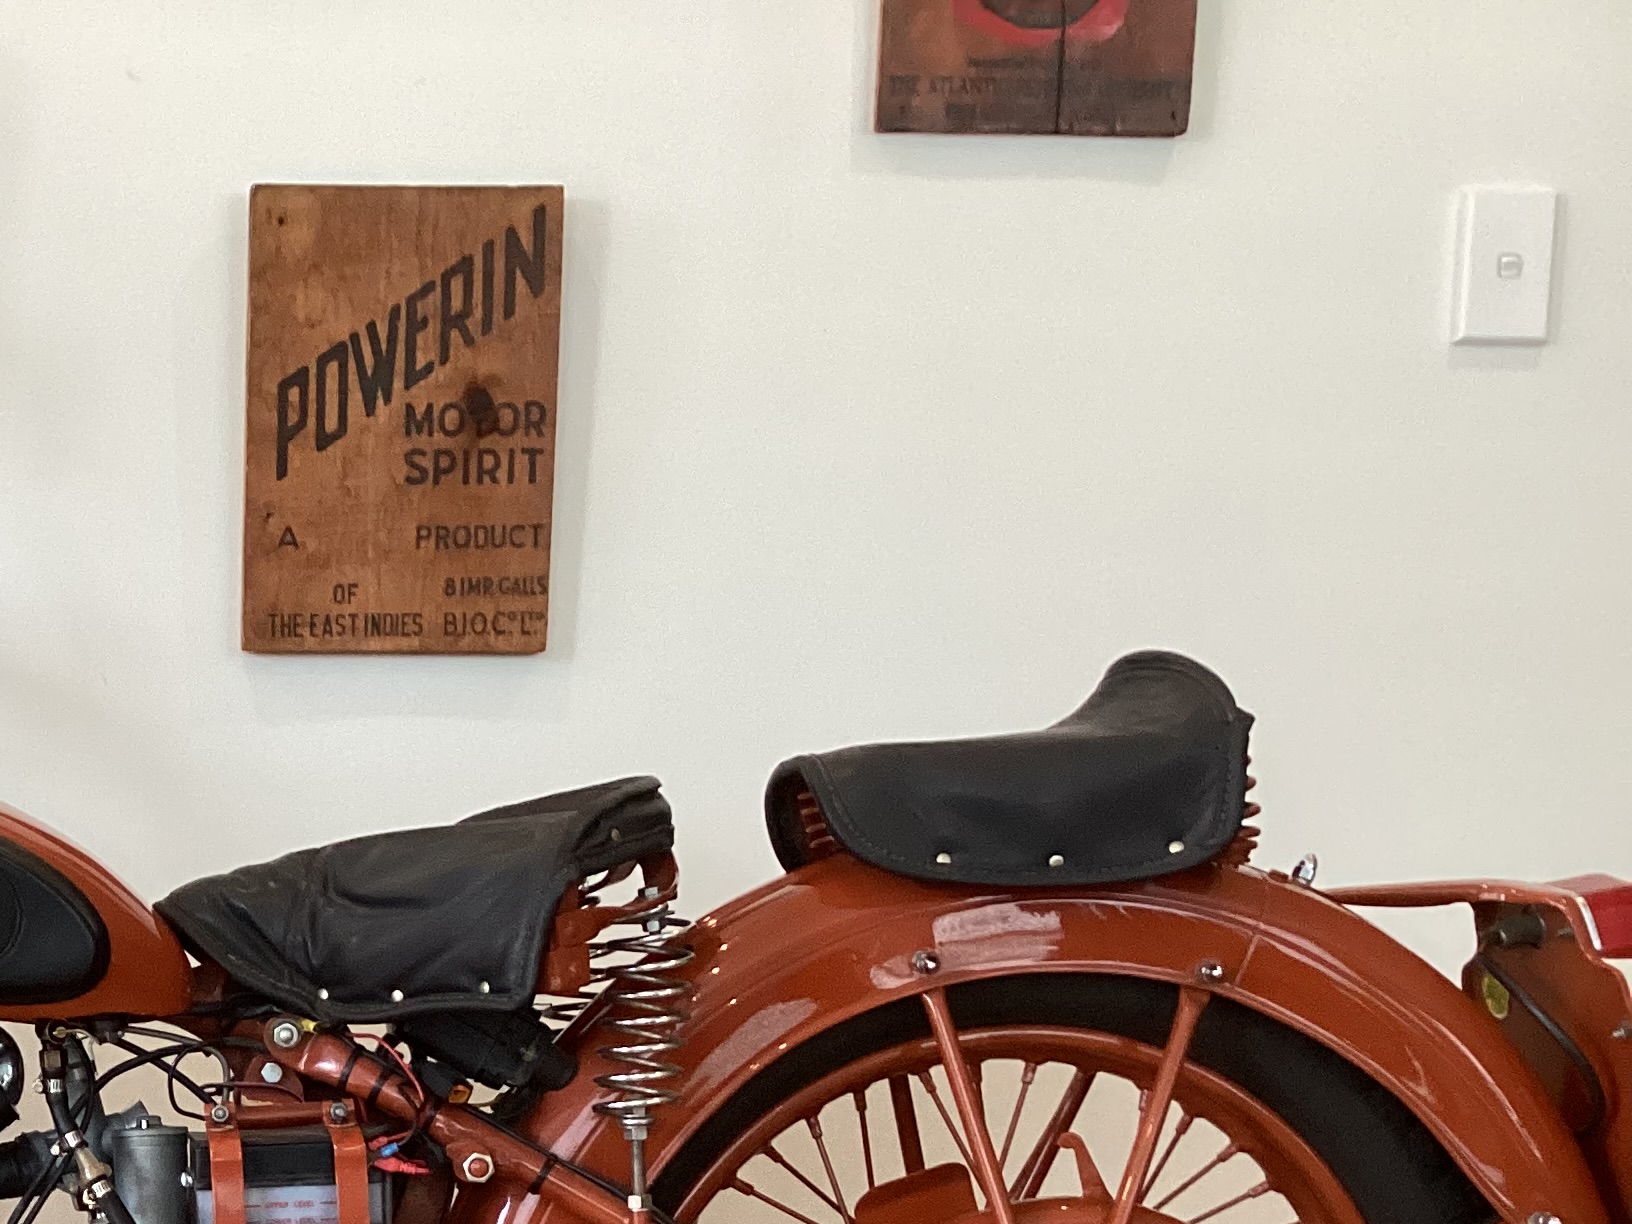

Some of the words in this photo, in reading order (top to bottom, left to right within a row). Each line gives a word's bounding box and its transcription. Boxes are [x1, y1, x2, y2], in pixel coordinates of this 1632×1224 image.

[275, 203, 547, 482] POWERIN
[404, 401, 547, 438] MOOR
[404, 447, 544, 486] SPIRIT
[278, 525, 299, 551] A
[415, 522, 545, 551] PRODUCT
[332, 582, 359, 605] OF
[269, 612, 304, 638] THE
[309, 612, 359, 637] EAST
[364, 612, 424, 637] INDIES
